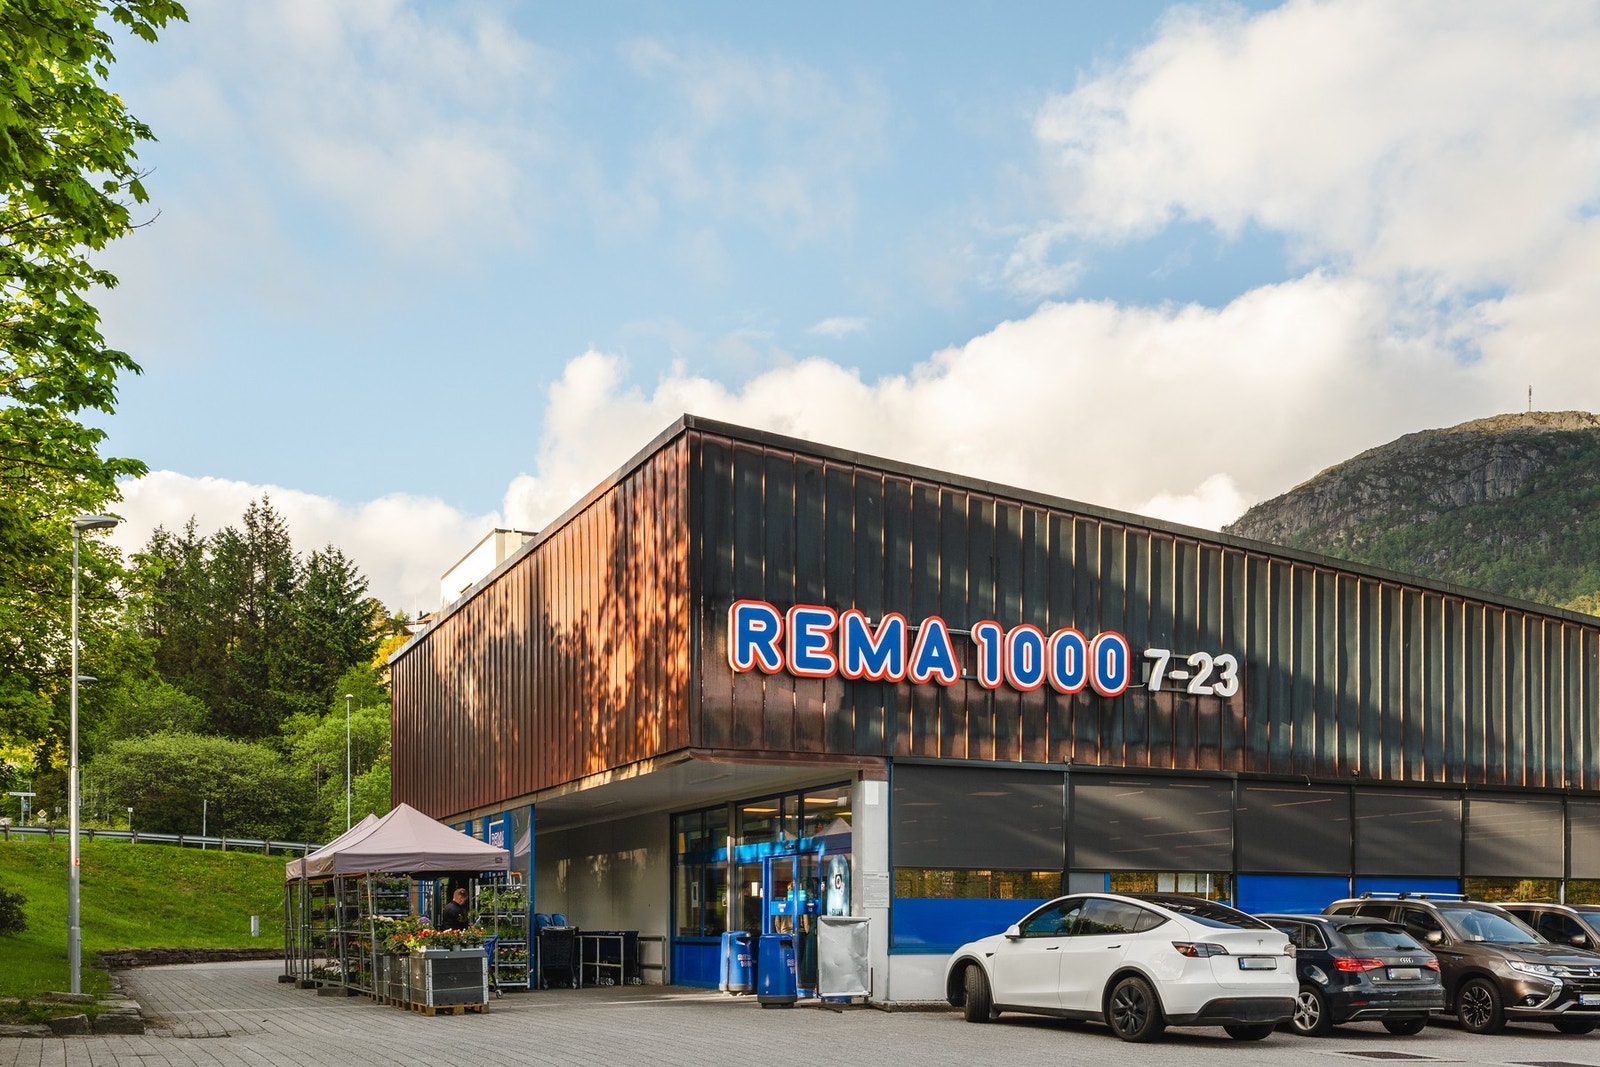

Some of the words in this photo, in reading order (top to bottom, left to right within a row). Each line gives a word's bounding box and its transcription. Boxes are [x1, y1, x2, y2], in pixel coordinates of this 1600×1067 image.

[728, 599, 960, 686] REMA
[971, 619, 1130, 697] 1000
[1144, 648, 1238, 697] 7-23
